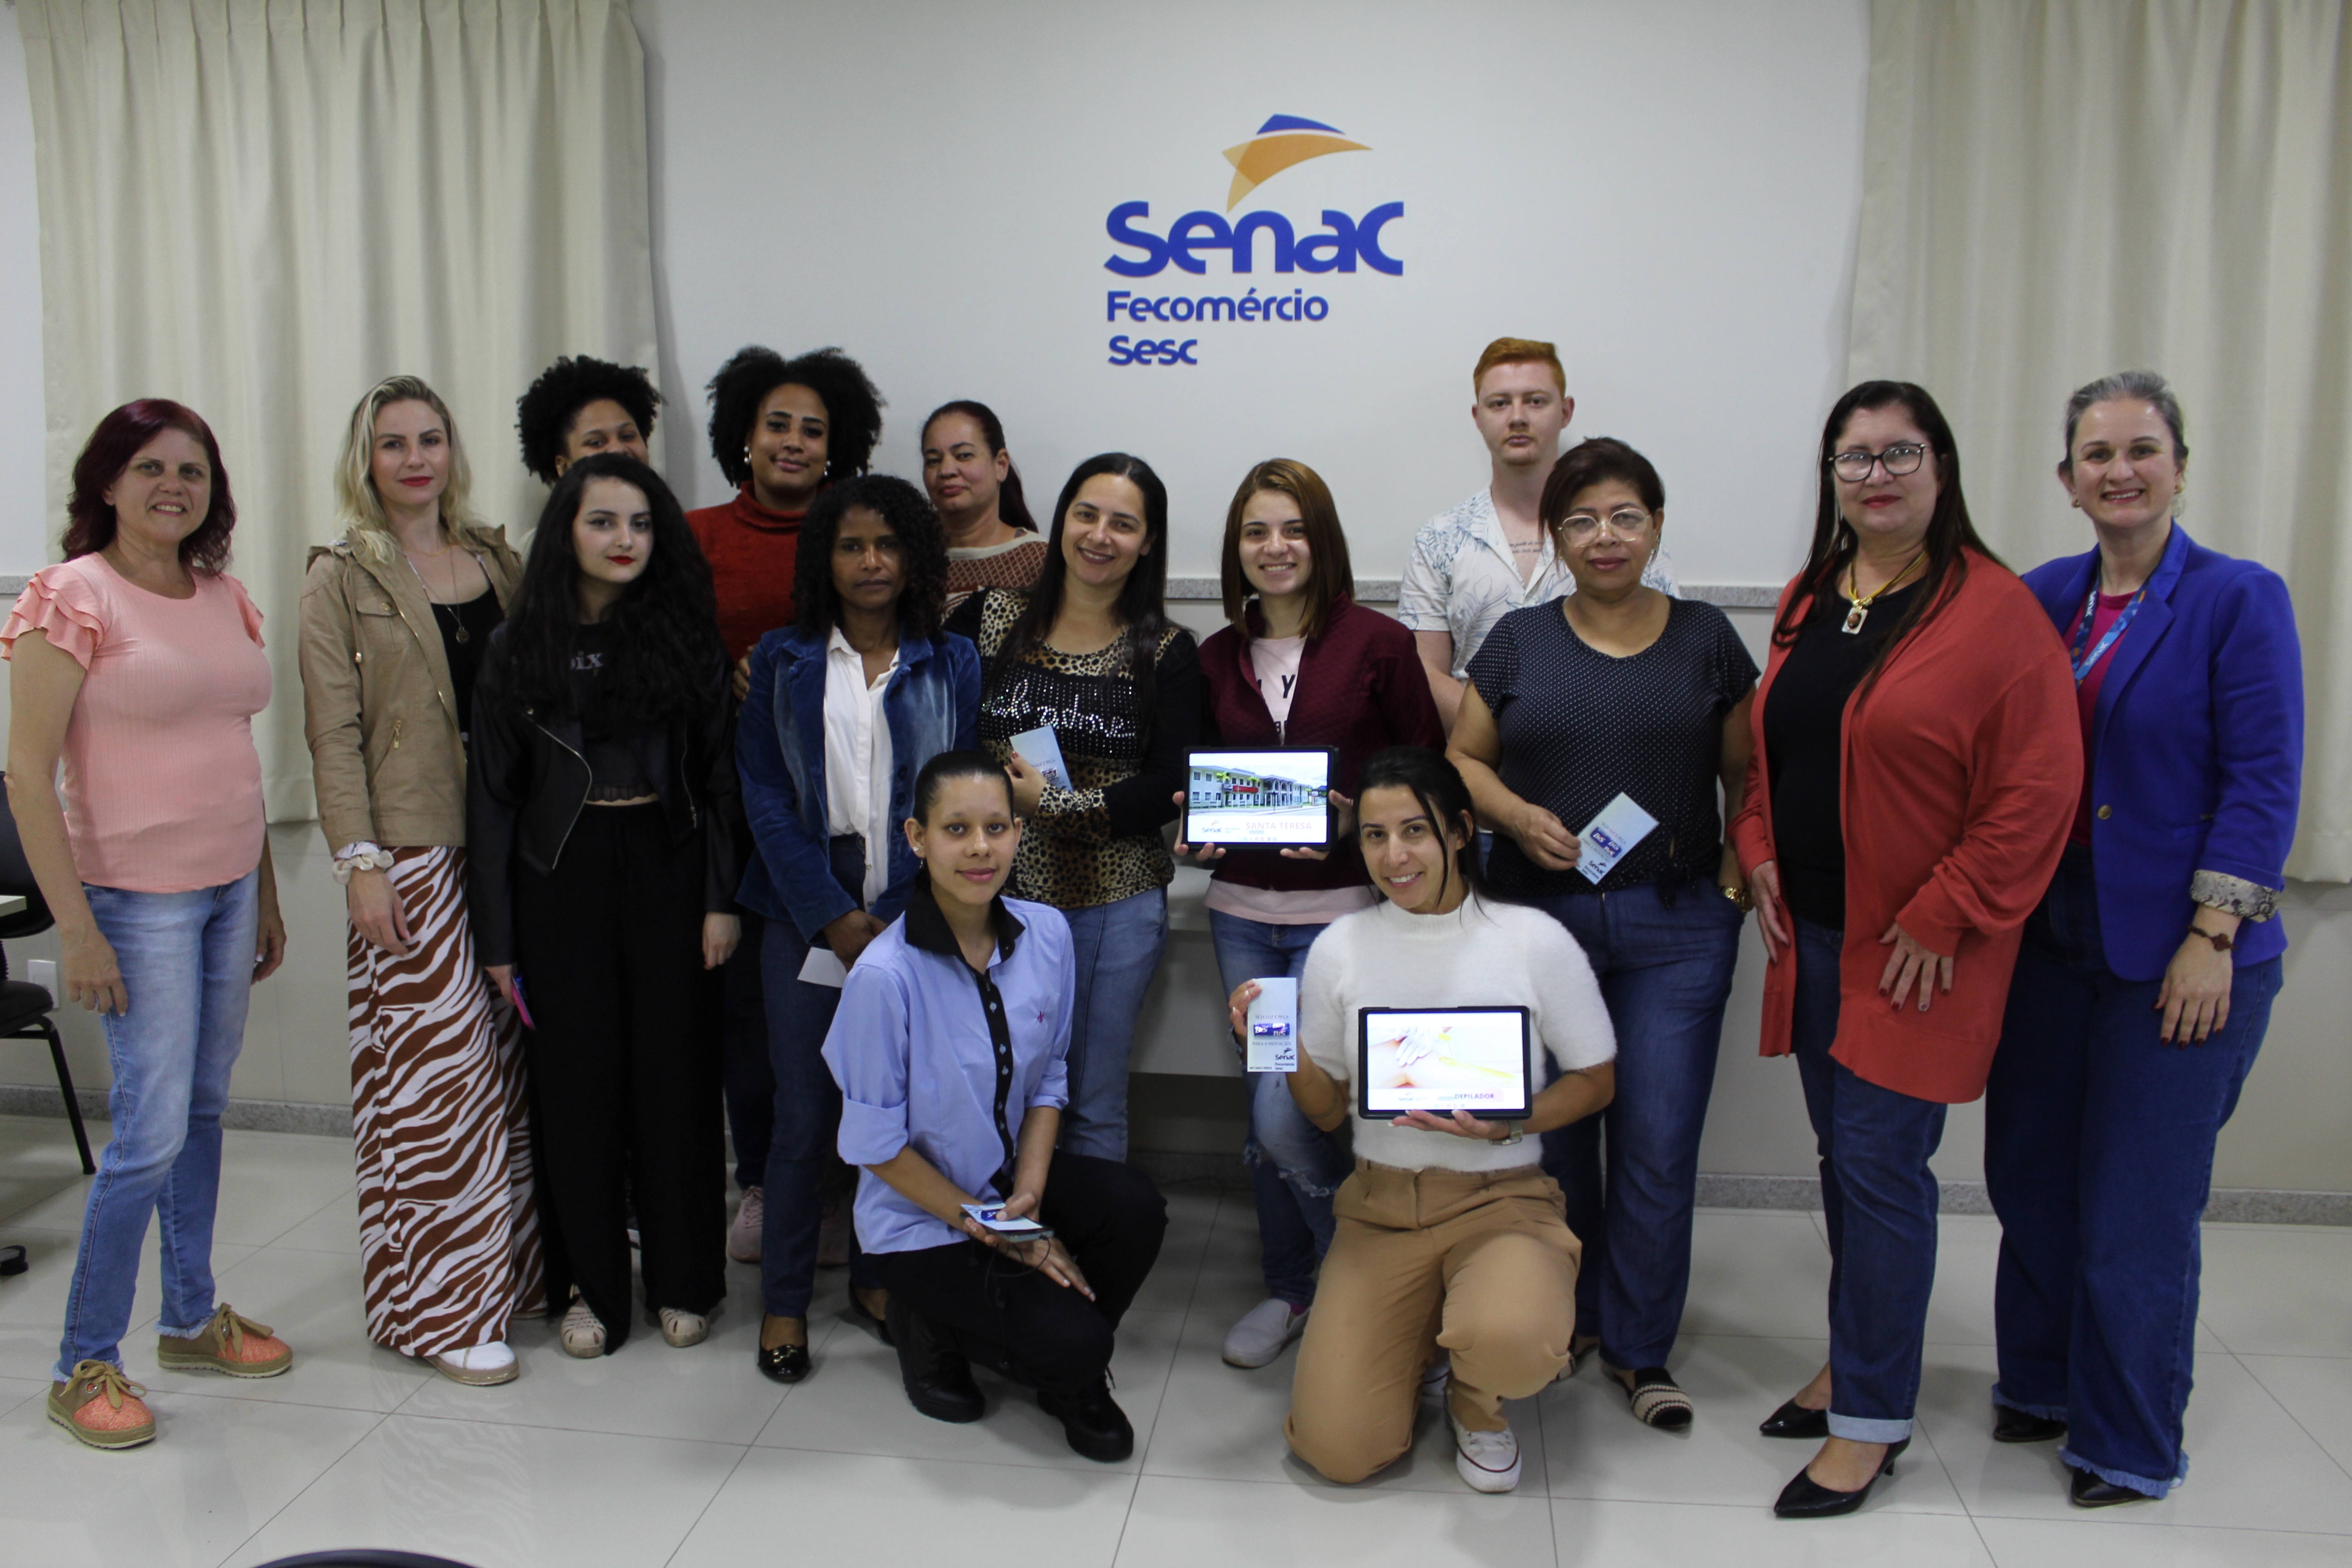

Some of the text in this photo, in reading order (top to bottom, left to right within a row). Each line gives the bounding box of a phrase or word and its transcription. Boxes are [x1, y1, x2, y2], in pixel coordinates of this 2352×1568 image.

[1103, 200, 1404, 278] Senac
[1107, 287, 1329, 322] Fecomércio
[1107, 335, 1197, 366] Sesc
